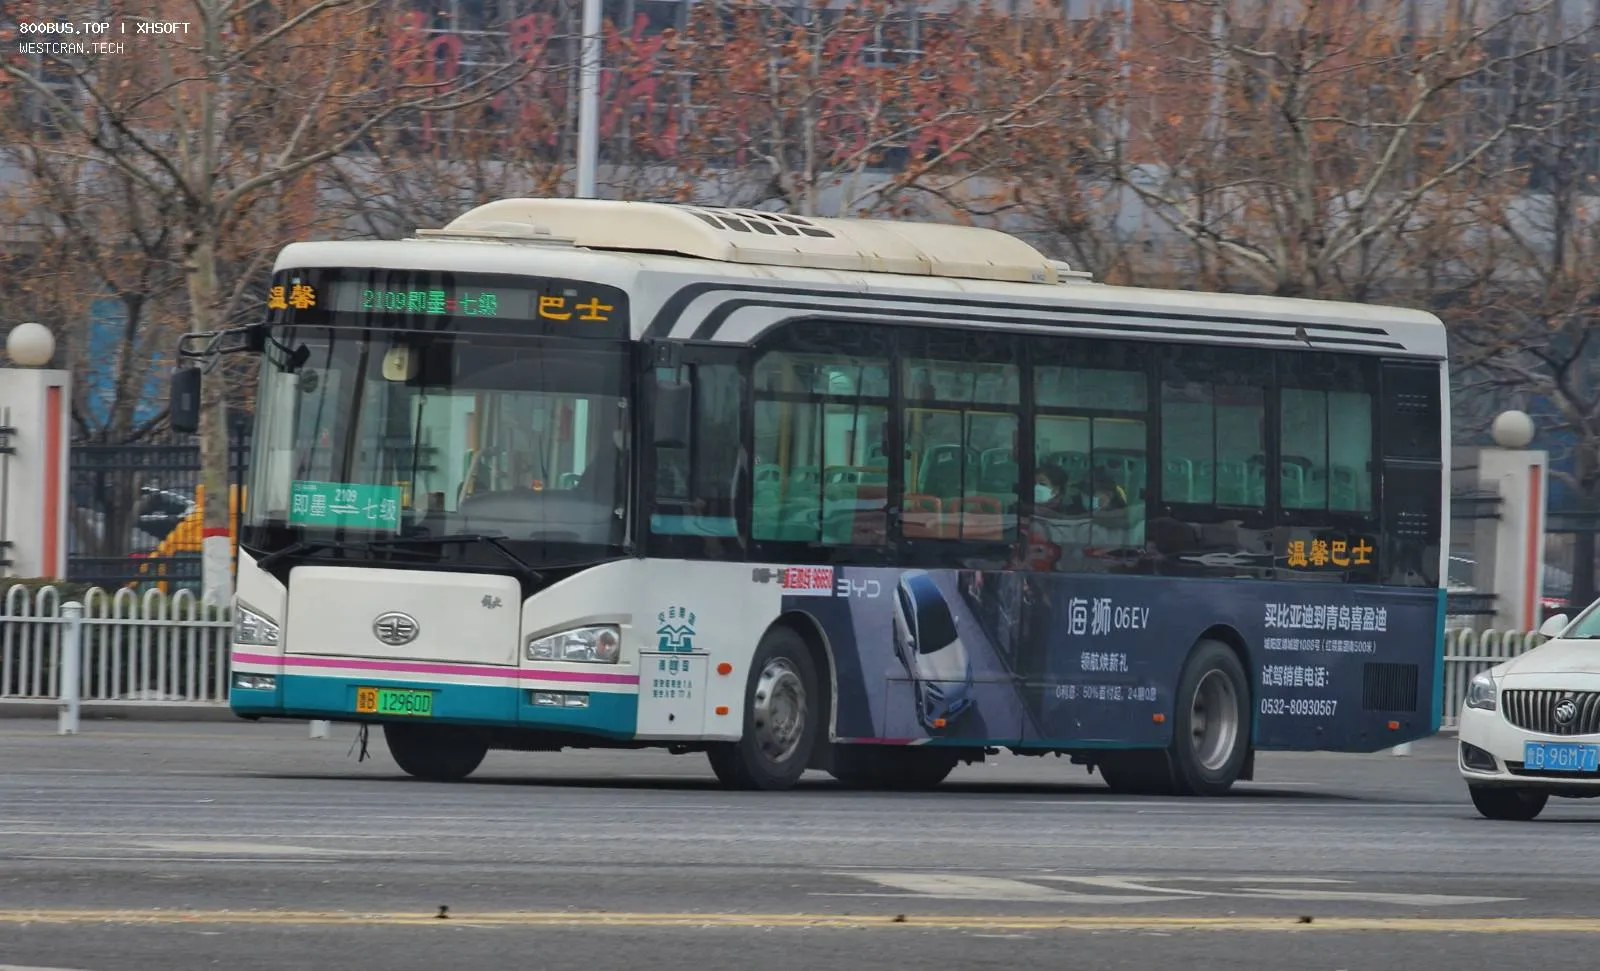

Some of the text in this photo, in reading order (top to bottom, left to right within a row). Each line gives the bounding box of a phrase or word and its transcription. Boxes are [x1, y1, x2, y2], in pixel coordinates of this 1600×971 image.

[538, 296, 614, 321] 巴士
[335, 488, 358, 503] 2109
[361, 497, 397, 521] 七级
[1287, 538, 1373, 567] 温馨巴士
[836, 578, 881, 598] BYD
[1264, 603, 1388, 632] 买比亚迪到青岛喜盈迪
[1260, 698, 1339, 716] 0532-80930567
